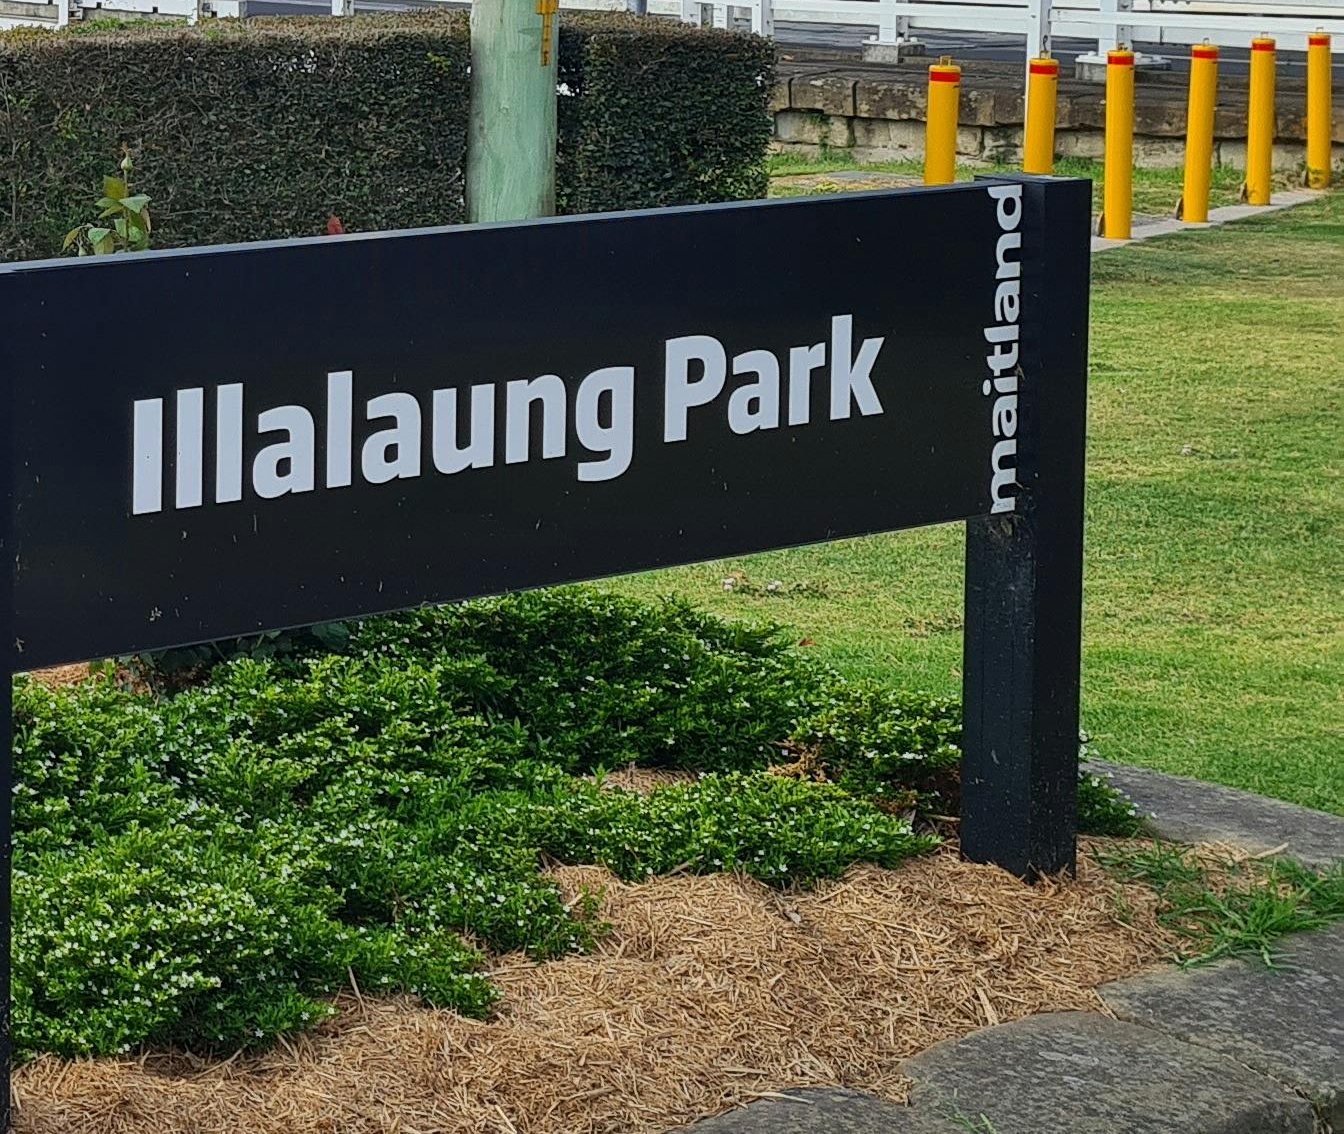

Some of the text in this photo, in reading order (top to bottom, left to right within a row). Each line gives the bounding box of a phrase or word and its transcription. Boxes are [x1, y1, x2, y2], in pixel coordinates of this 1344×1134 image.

[133, 314, 885, 516] Illalaung Park
[983, 183, 1023, 514] maitland
